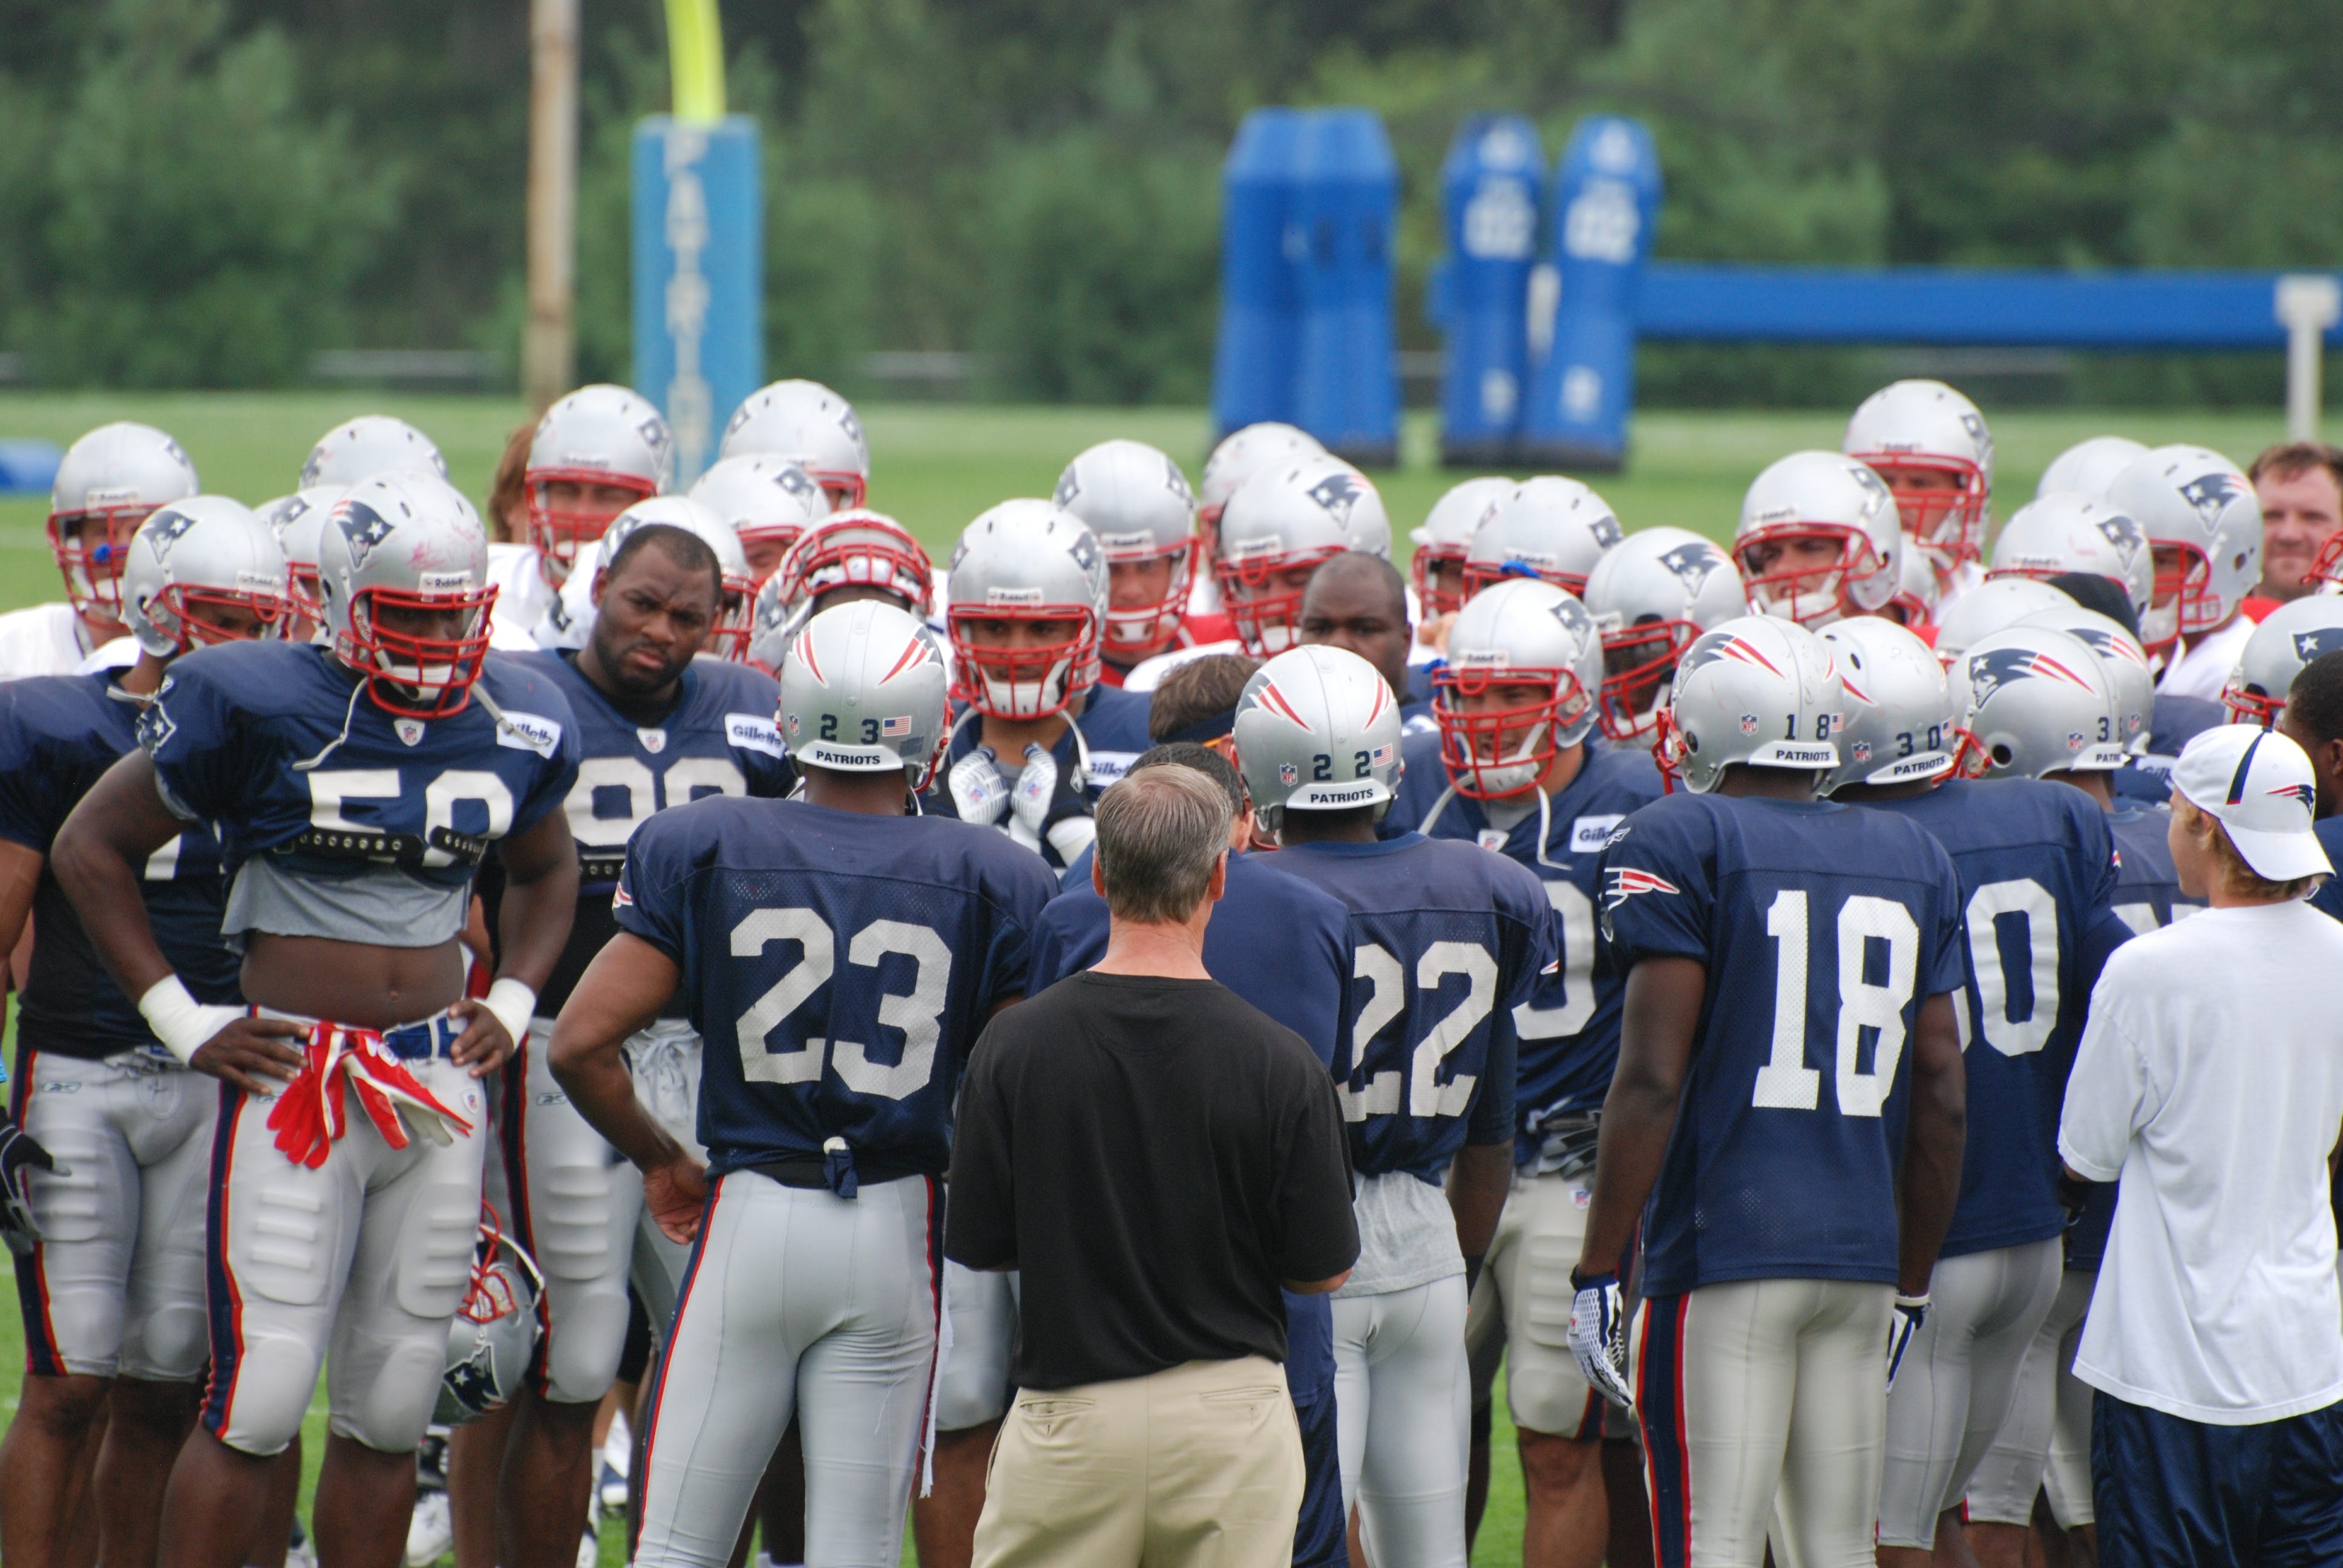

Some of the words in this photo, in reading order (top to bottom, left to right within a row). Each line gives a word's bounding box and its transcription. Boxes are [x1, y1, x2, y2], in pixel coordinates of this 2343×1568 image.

[820, 713, 879, 745] 23
[1784, 714, 1830, 740] 18
[1896, 725, 1940, 757] 30
[816, 750, 880, 766] PATRIOTS
[1313, 751, 1371, 781] 22
[1776, 750, 1830, 760] PATRIOTS
[1894, 756, 1945, 776] PATRIOTS
[1310, 788, 1374, 803] PATRIOTS
[730, 908, 952, 1100] 23
[1752, 890, 1919, 1117] 18
[1340, 941, 1498, 1123] 22
